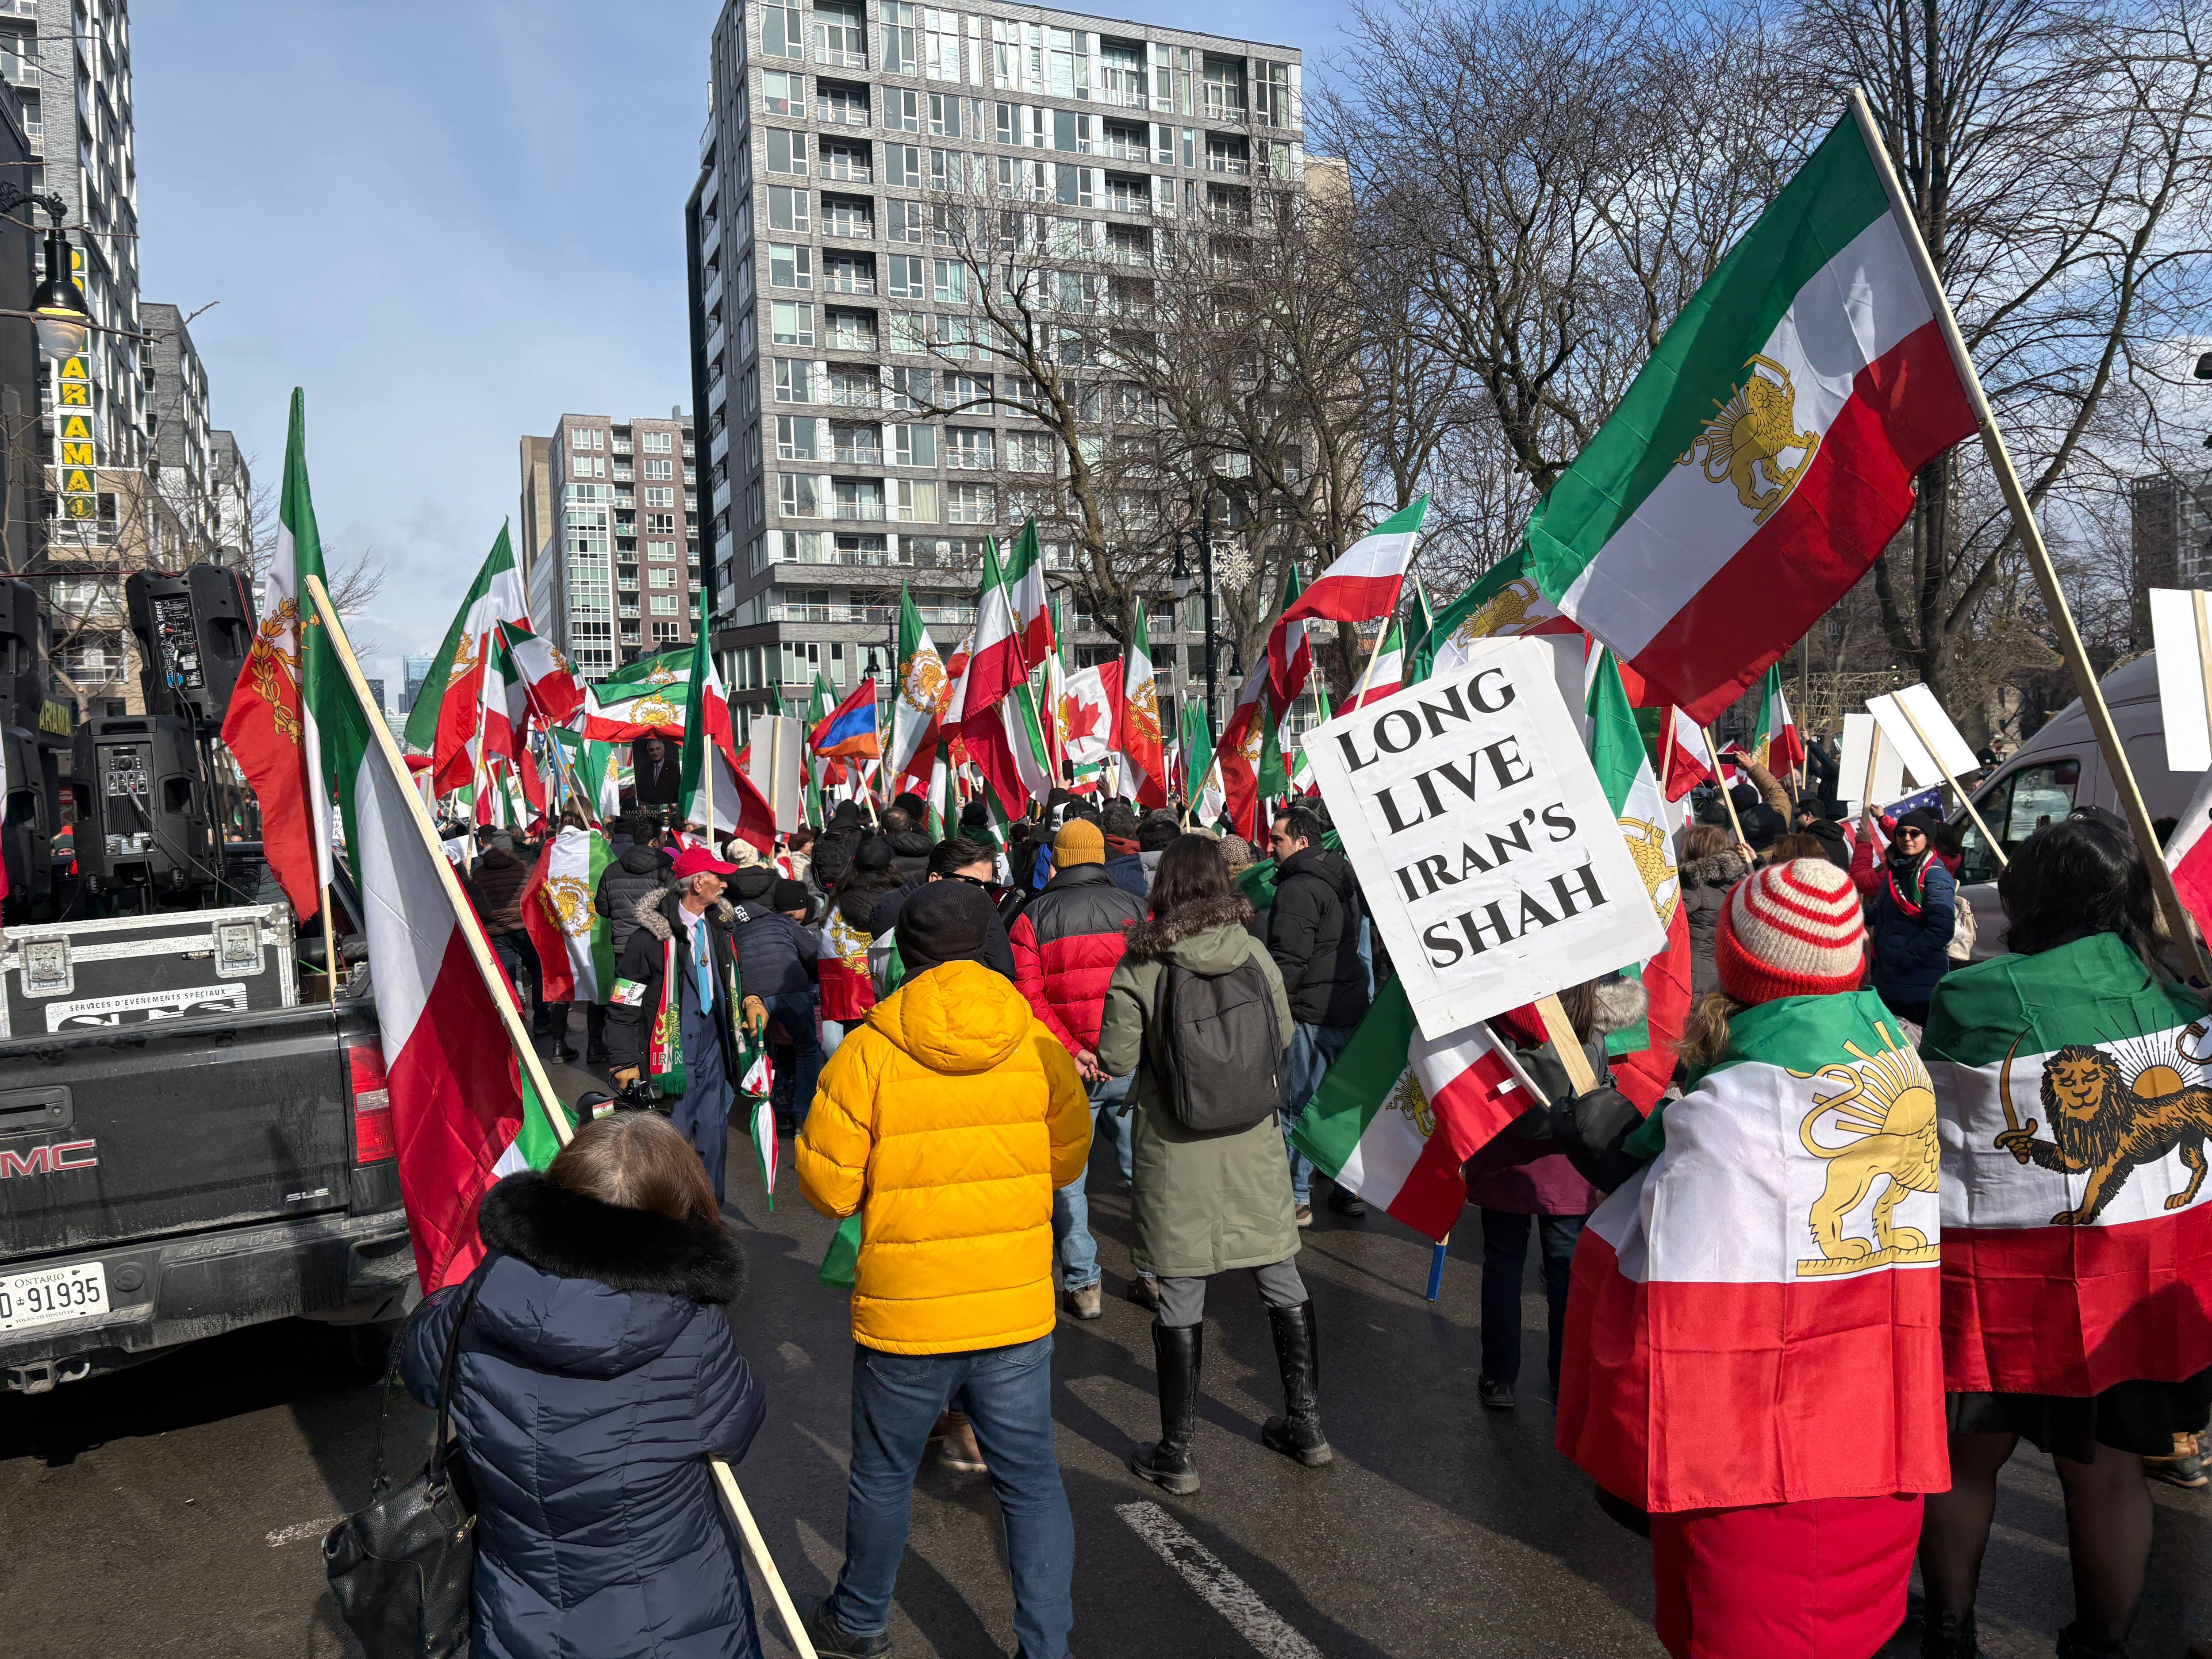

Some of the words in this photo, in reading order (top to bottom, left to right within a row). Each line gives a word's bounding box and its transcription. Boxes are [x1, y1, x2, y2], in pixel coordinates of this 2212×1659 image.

[155, 601, 164, 622] SERIES
[1333, 668, 1516, 774] LONG
[1371, 735, 1534, 836] LIVE
[1392, 802, 1576, 903] IRAN'S
[1423, 862, 1610, 968] SHAH
[69, 1001, 111, 1011] SERVICES
[185, 989, 226, 999] SPÉCIAUX
[653, 1051, 683, 1066] IRAN
[286, 1188, 329, 1202] SLE
[15, 1273, 64, 1288] ONTARIO
[27, 1277, 100, 1313] 91935
[46, 1309, 75, 1317] DISCOVER
